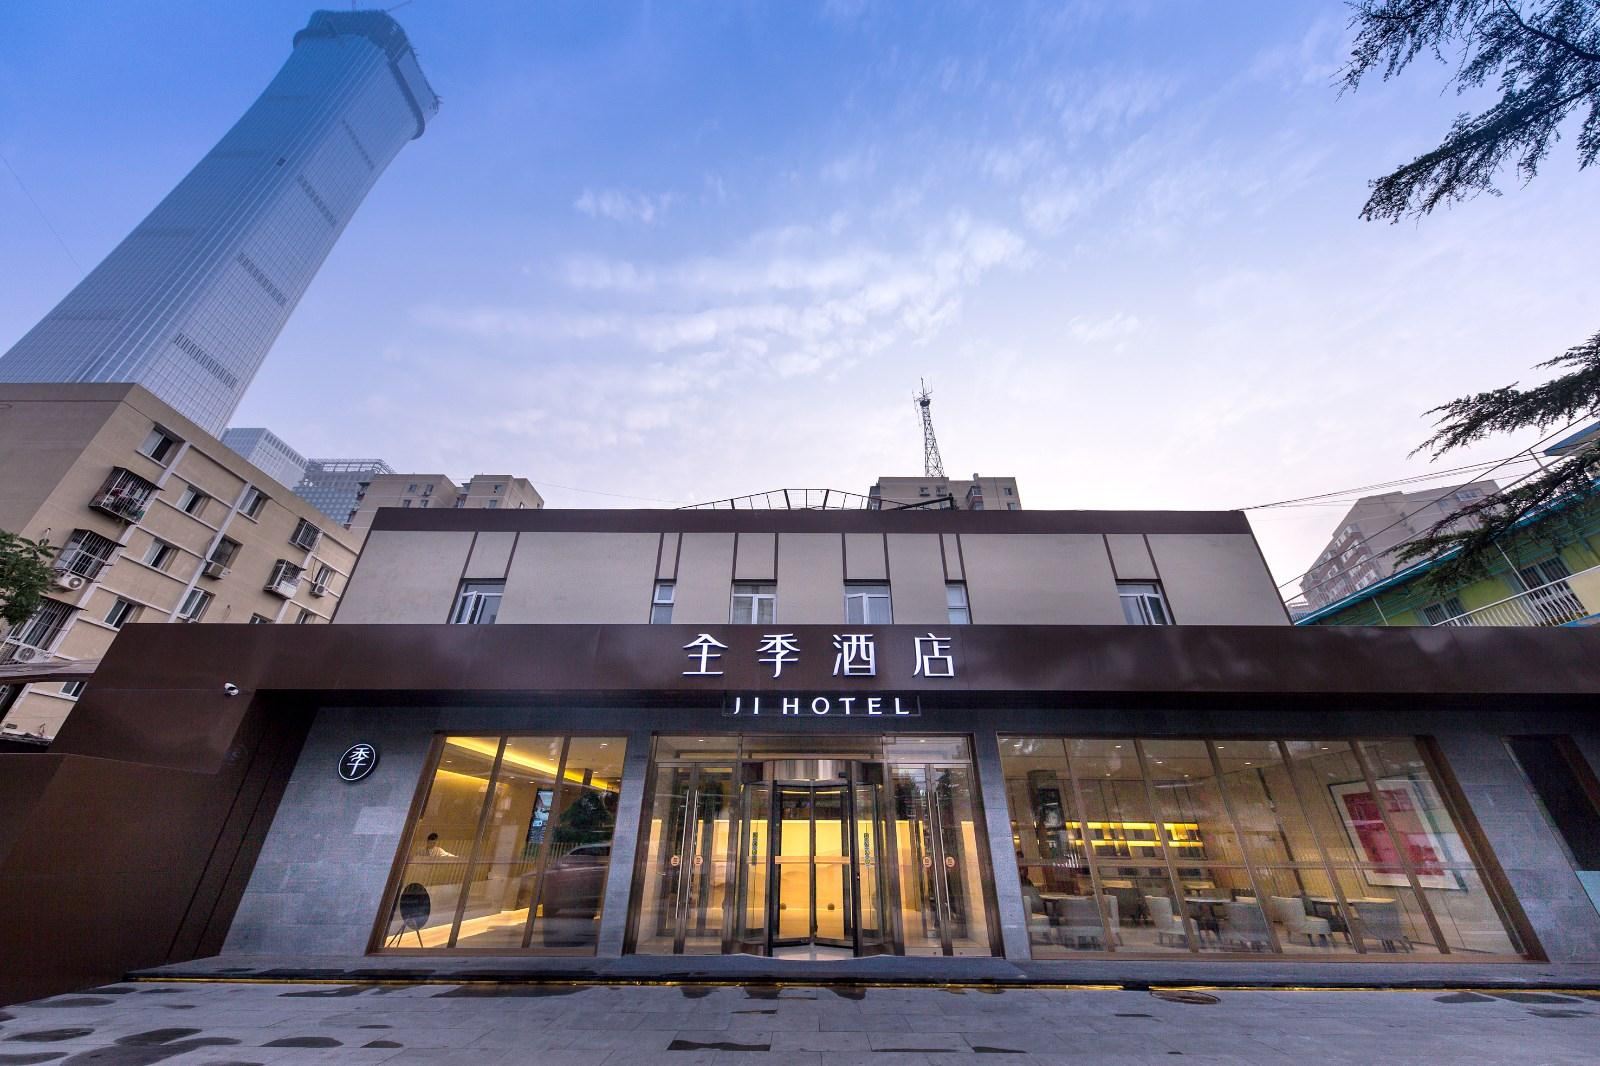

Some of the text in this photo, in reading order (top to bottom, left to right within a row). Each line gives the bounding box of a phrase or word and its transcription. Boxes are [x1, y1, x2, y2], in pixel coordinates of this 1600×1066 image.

[682, 632, 955, 678] 全季酒店
[733, 696, 911, 715] JI HOTEL
[347, 747, 370, 777] 季
